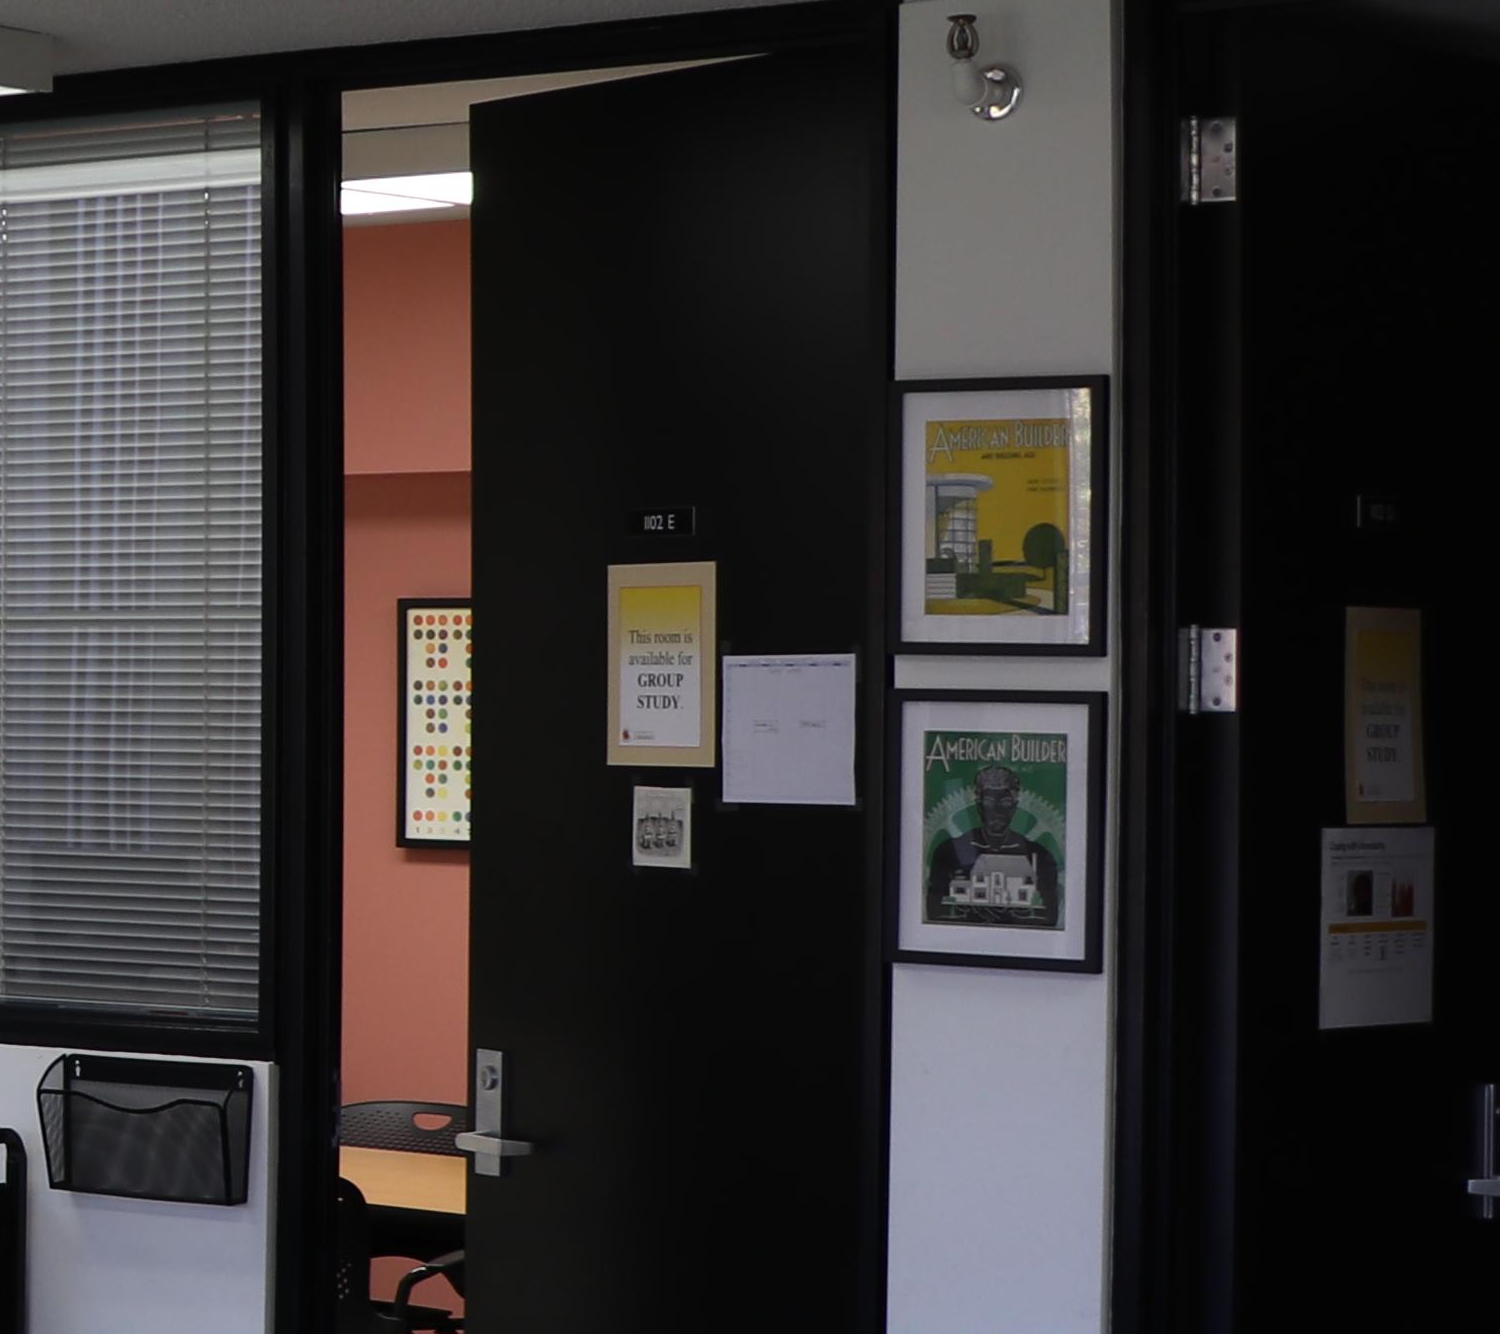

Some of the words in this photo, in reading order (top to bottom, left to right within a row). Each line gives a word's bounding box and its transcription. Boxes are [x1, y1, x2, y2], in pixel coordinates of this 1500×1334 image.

[644, 515, 664, 530] 1102
[668, 514, 675, 530] E
[628, 630, 652, 644] This
[654, 633, 680, 644] room
[684, 630, 693, 643] is
[628, 651, 675, 666] available
[678, 651, 693, 666] for
[637, 673, 684, 688] GROUP
[926, 735, 1005, 771] AMERICAN
[1011, 734, 1067, 763] BUILDER
